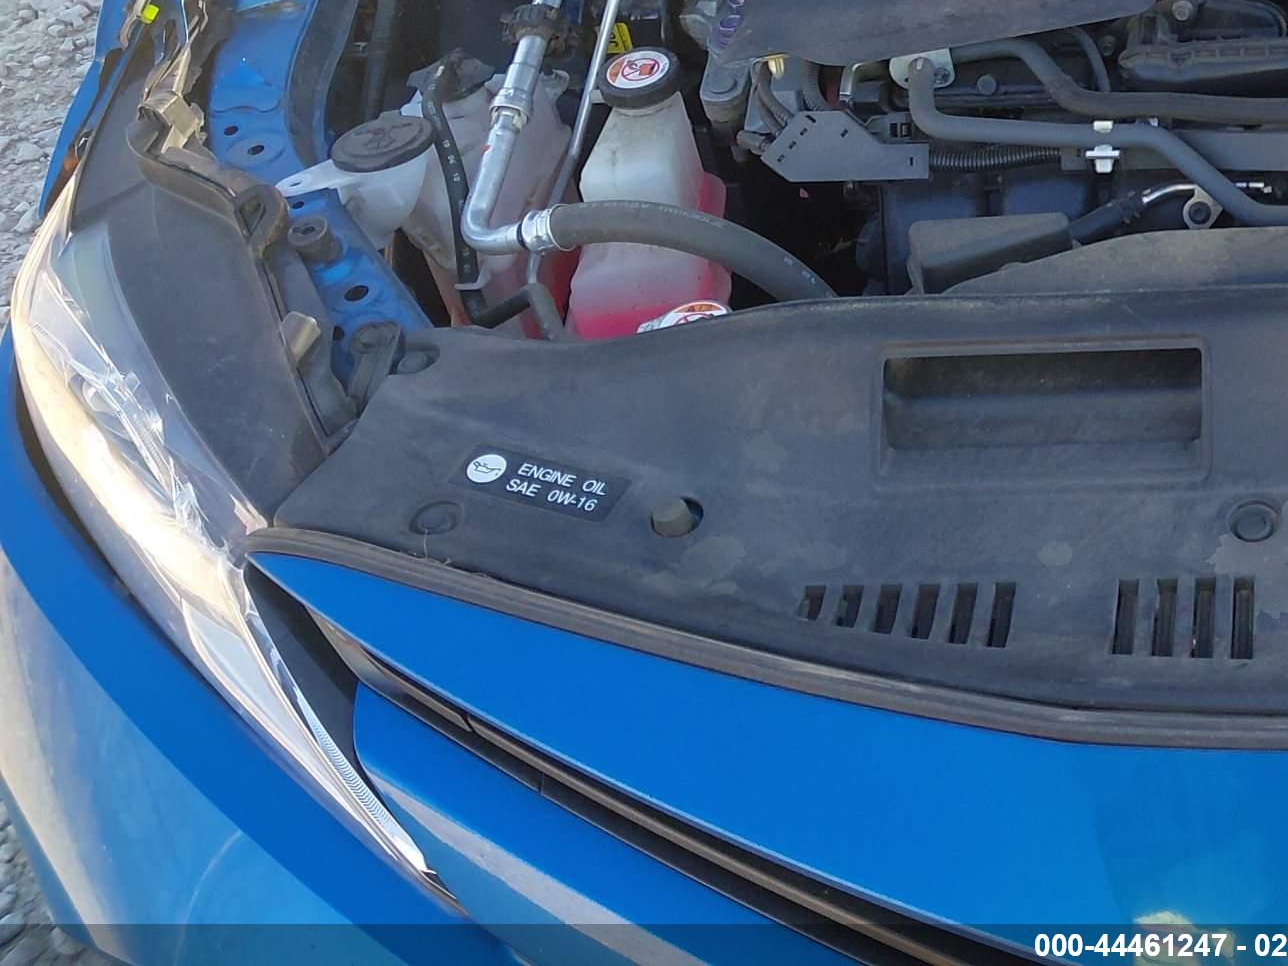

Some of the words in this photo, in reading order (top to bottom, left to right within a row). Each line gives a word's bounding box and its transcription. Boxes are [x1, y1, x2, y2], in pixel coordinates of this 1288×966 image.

[505, 479, 541, 497] SAE
[547, 490, 598, 512] 0W-16
[518, 463, 577, 487] ENGINE
[582, 480, 607, 496] OIL
